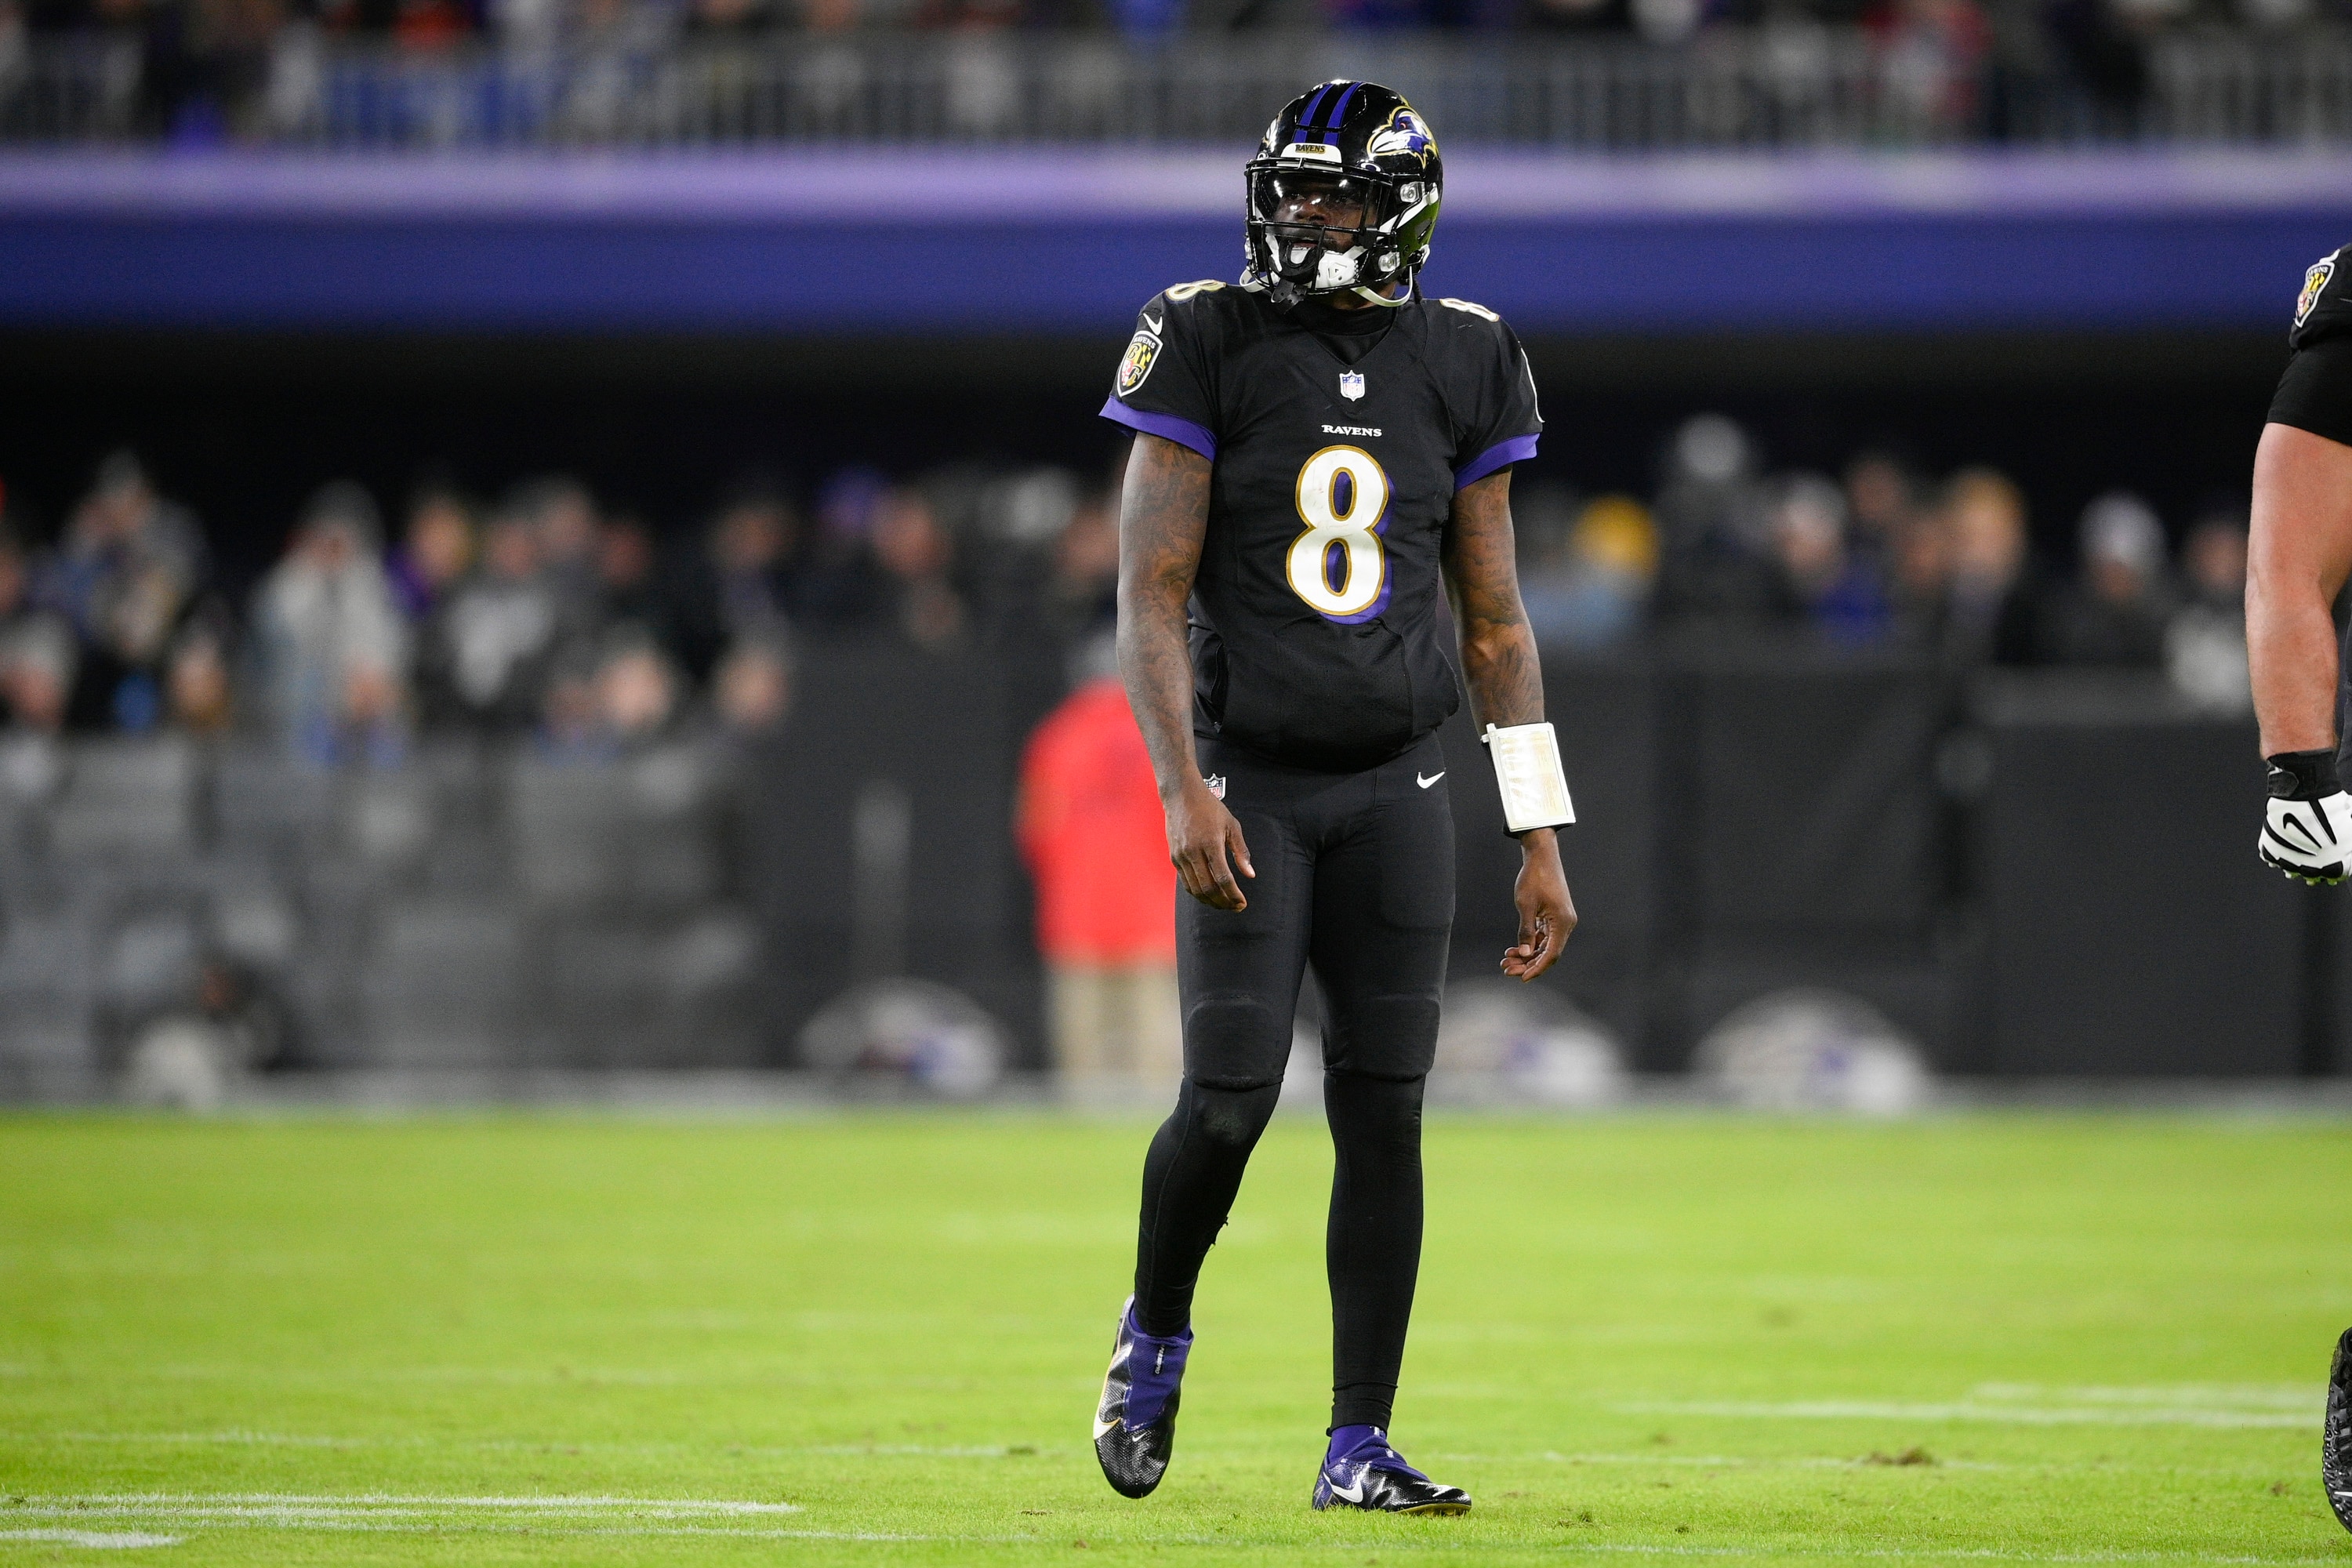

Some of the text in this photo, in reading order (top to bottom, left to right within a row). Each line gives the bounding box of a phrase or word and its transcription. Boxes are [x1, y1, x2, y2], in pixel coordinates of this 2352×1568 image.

[1295, 144, 1326, 154] RAVENS
[1166, 278, 1226, 303] 8
[1439, 297, 1500, 322] 8
[1321, 424, 1382, 437] RAVENS
[1286, 445, 1394, 622] 8
